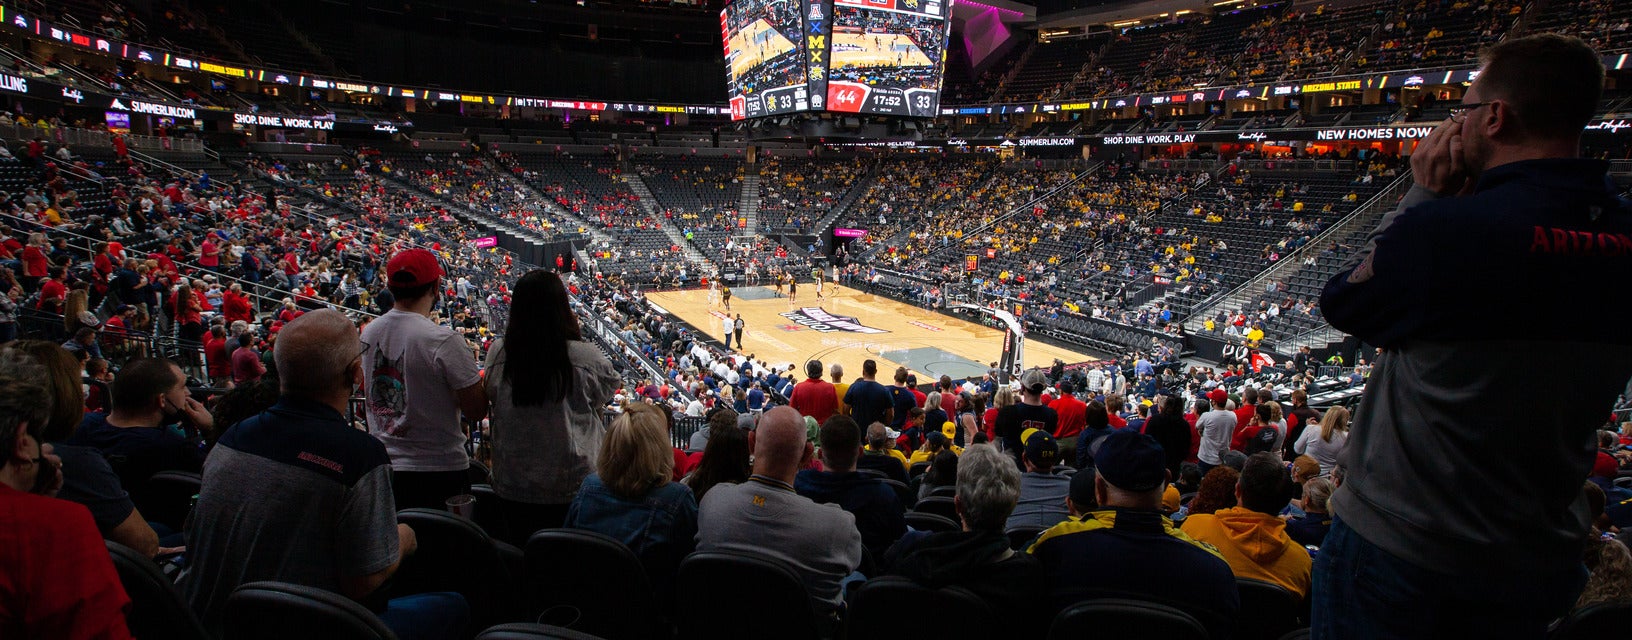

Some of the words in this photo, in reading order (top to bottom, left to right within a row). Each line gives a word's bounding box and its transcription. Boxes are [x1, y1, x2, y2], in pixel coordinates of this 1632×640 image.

[808, 36, 824, 49] M
[336, 82, 368, 92] COLORADO
[1302, 82, 1335, 93] ARIZONA
[1336, 80, 1361, 90] STATE
[780, 95, 792, 108] 33
[836, 90, 855, 104] 44
[873, 96, 900, 106] 17:52
[916, 96, 930, 108] 33
[131, 100, 196, 119] SUMMERLIN.COM
[234, 113, 257, 124] SHOP.
[258, 115, 282, 126] DINE.
[283, 118, 312, 128] WORK.
[314, 121, 334, 130] PLAY
[1125, 136, 1144, 144] DINE.
[1146, 135, 1172, 144] WORK.
[1174, 134, 1196, 143] PLAY
[1317, 130, 1345, 140] NEW
[1348, 129, 1393, 140] HOMES
[1396, 128, 1432, 138] NOW
[967, 261, 976, 270] 30
[752, 495, 765, 507] M
